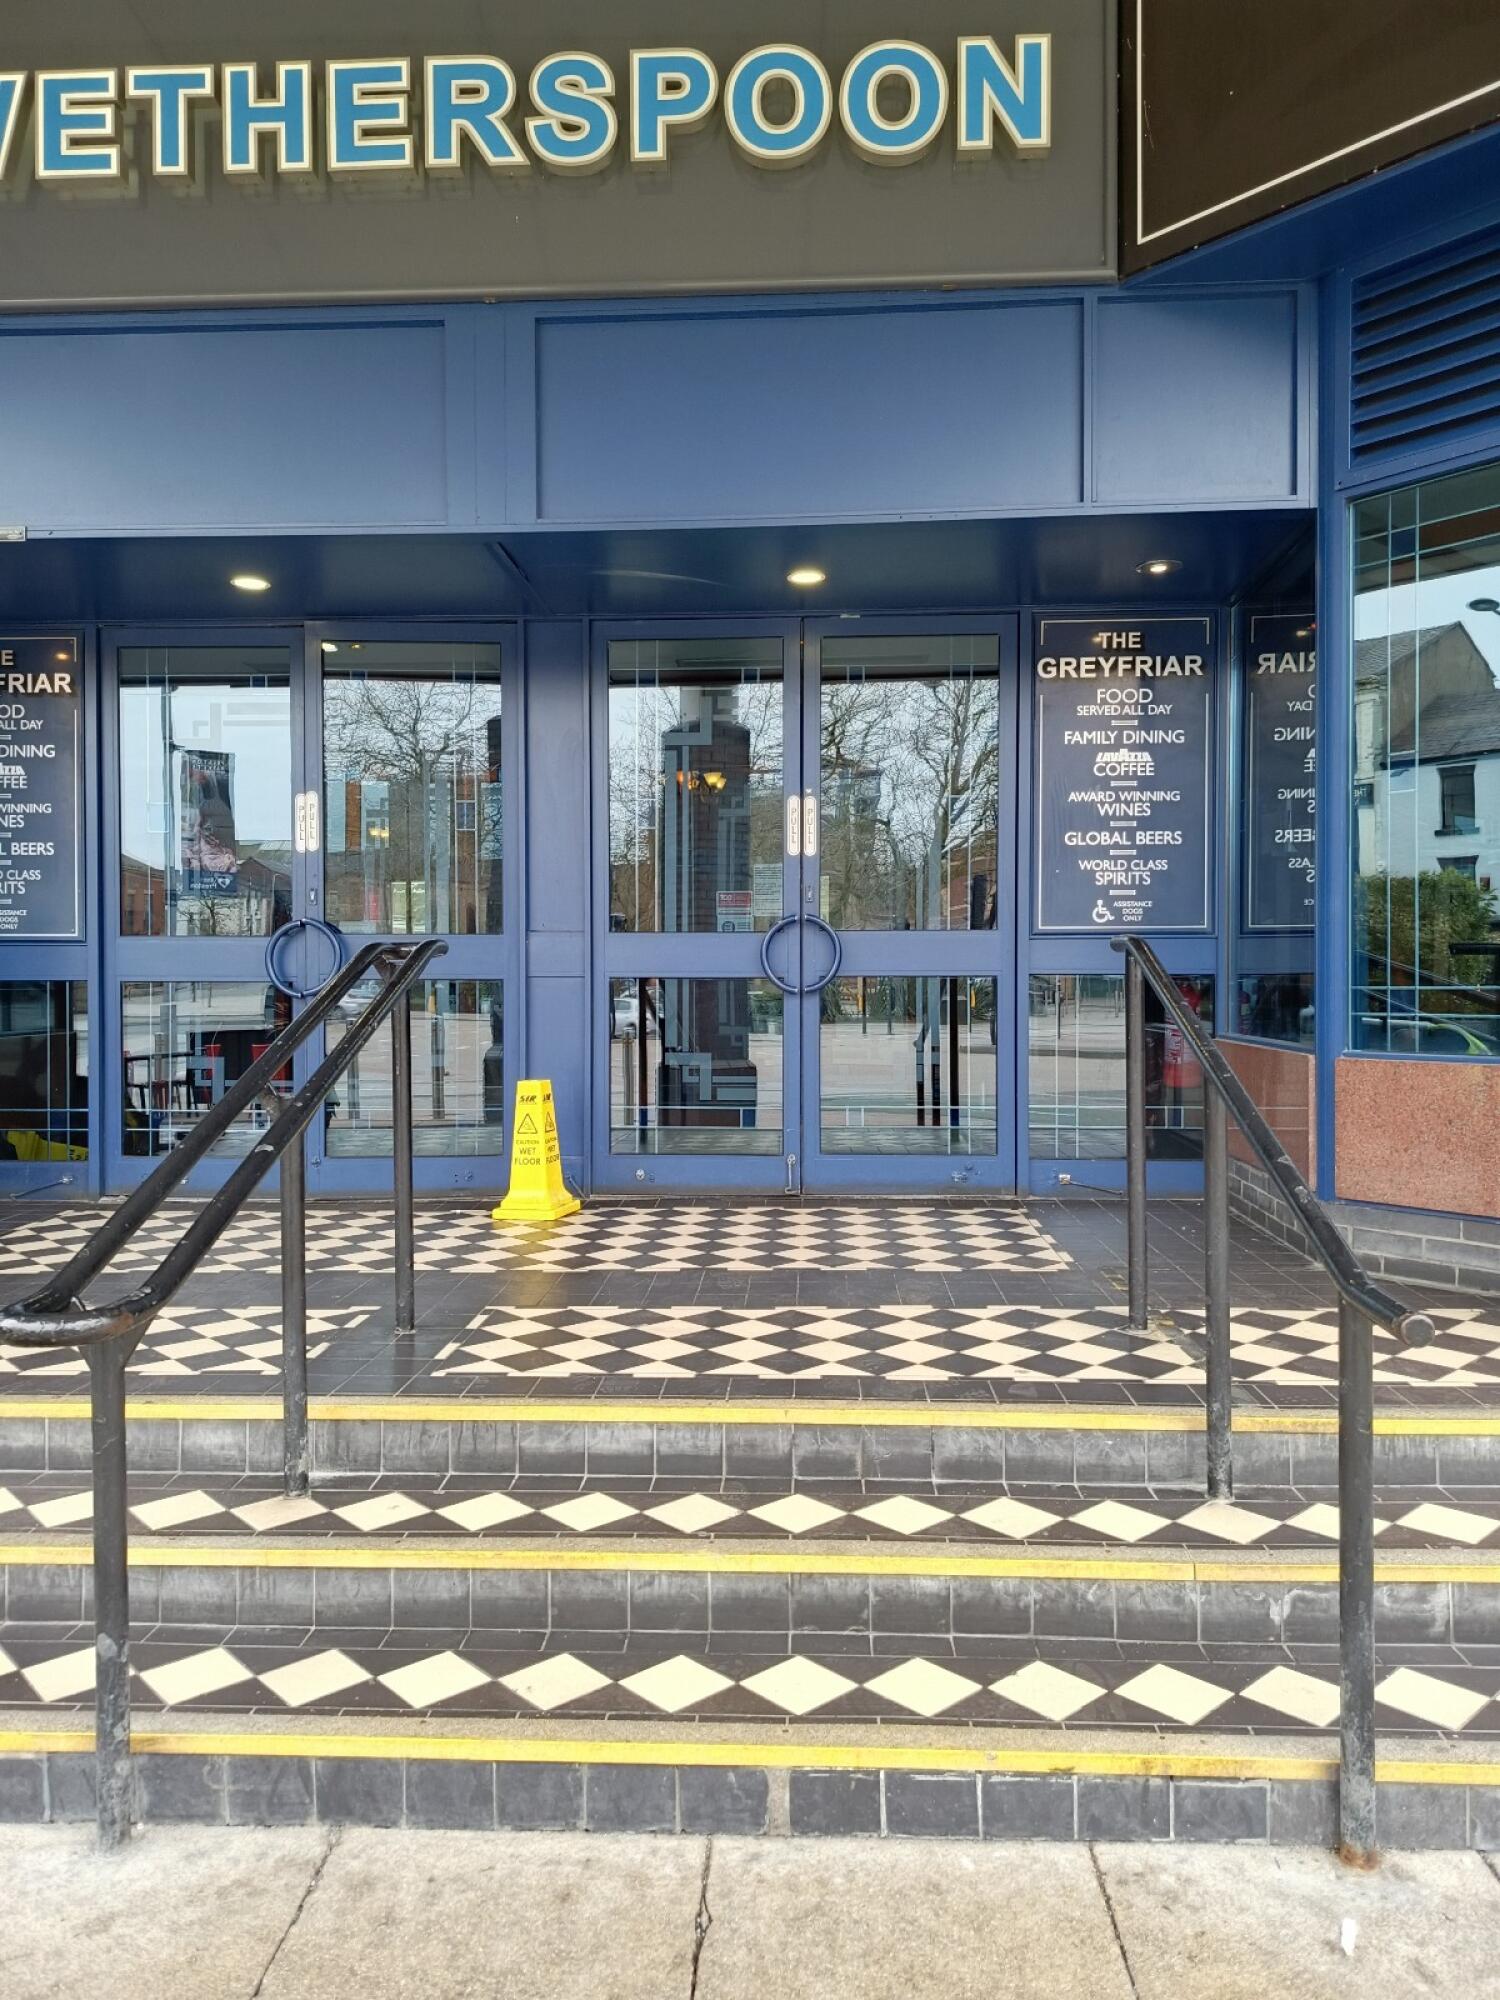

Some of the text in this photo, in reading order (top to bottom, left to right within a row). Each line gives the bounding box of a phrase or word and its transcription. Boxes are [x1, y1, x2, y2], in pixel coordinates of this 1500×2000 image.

[1098, 632, 1142, 648] THE
[1037, 655, 1204, 679] GREYFRIAR
[1097, 688, 1153, 704] FOOD
[1076, 704, 1173, 716] SERVED ALL DAY
[20, 719, 44, 730] DAY
[1064, 730, 1185, 744] FAMILY DINING
[1093, 762, 1155, 776] COFFEE
[1067, 790, 1181, 802] AWARD WINNING
[1097, 803, 1151, 816] WINES
[1064, 831, 1182, 846] GLOBAL BEERS
[10, 842, 54, 855] BEERS
[1078, 859, 1168, 870] WORLD CLASS
[6, 870, 41, 880] CLASS
[1095, 872, 1151, 885] SPIRITS
[519, 1147, 537, 1155] WET
[514, 1157, 541, 1166] FLOOR
